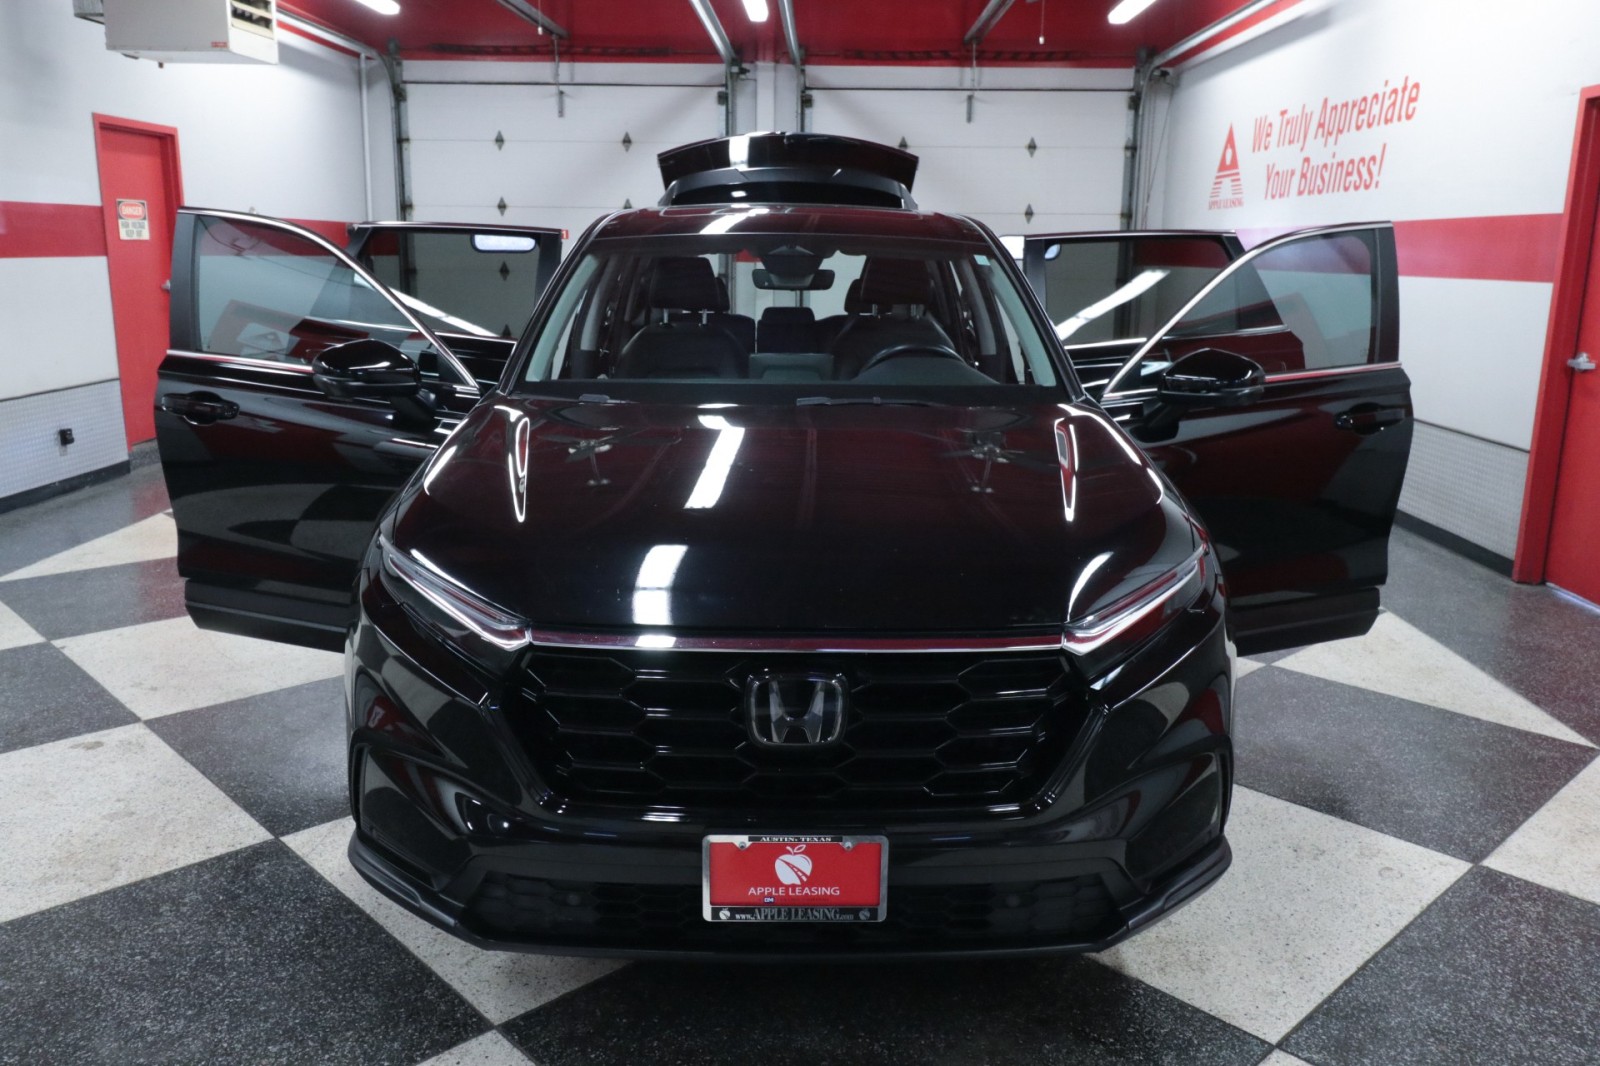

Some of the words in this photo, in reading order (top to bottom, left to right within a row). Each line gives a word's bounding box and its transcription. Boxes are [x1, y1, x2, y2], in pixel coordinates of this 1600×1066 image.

[1252, 115, 1273, 153] We
[1276, 103, 1314, 152] Truly
[1314, 75, 1421, 148] Appreciate
[1264, 162, 1296, 200] Your
[1296, 142, 1388, 197] Business!
[748, 887, 785, 896] APPLE
[788, 887, 840, 896] LEASING
